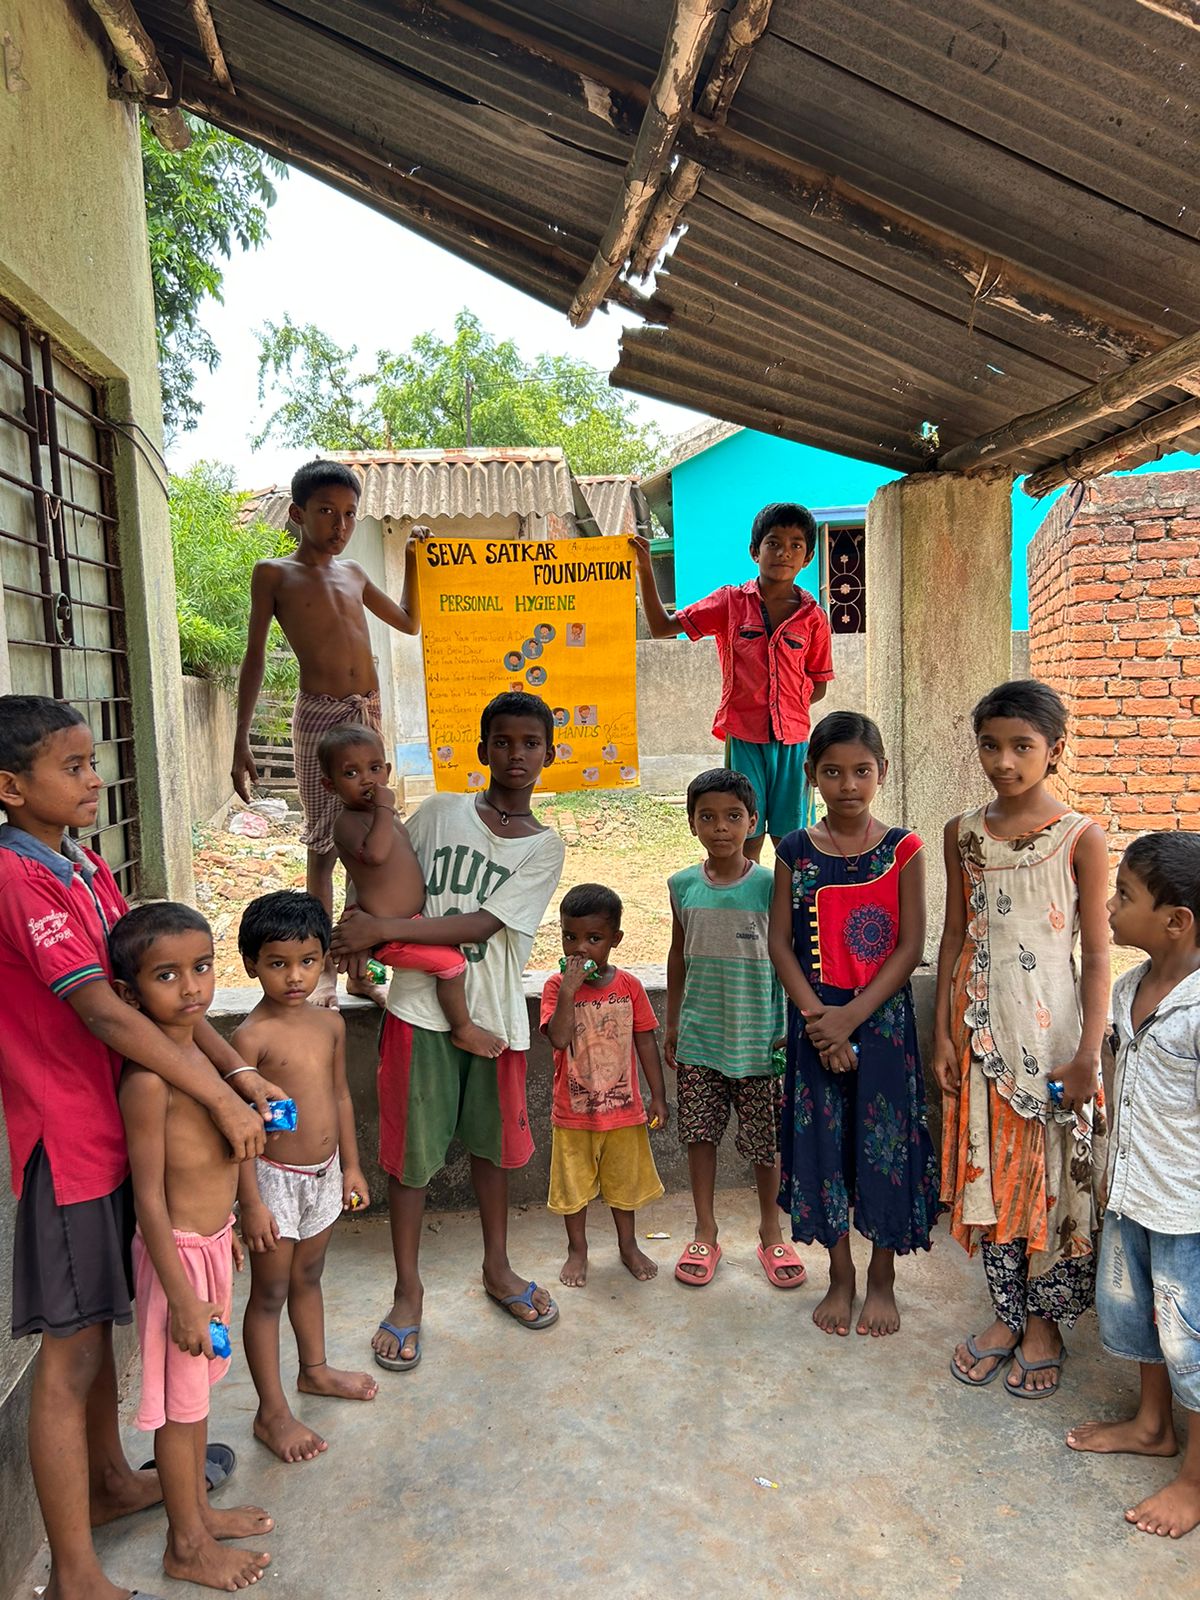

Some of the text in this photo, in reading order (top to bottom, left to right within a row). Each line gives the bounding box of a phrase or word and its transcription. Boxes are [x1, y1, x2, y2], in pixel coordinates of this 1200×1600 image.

[426, 542, 476, 567] SEVA
[485, 542, 558, 564] SATKAR
[533, 560, 632, 585] FOUNDATION
[440, 594, 576, 612] PERSONAL HYGIENE
